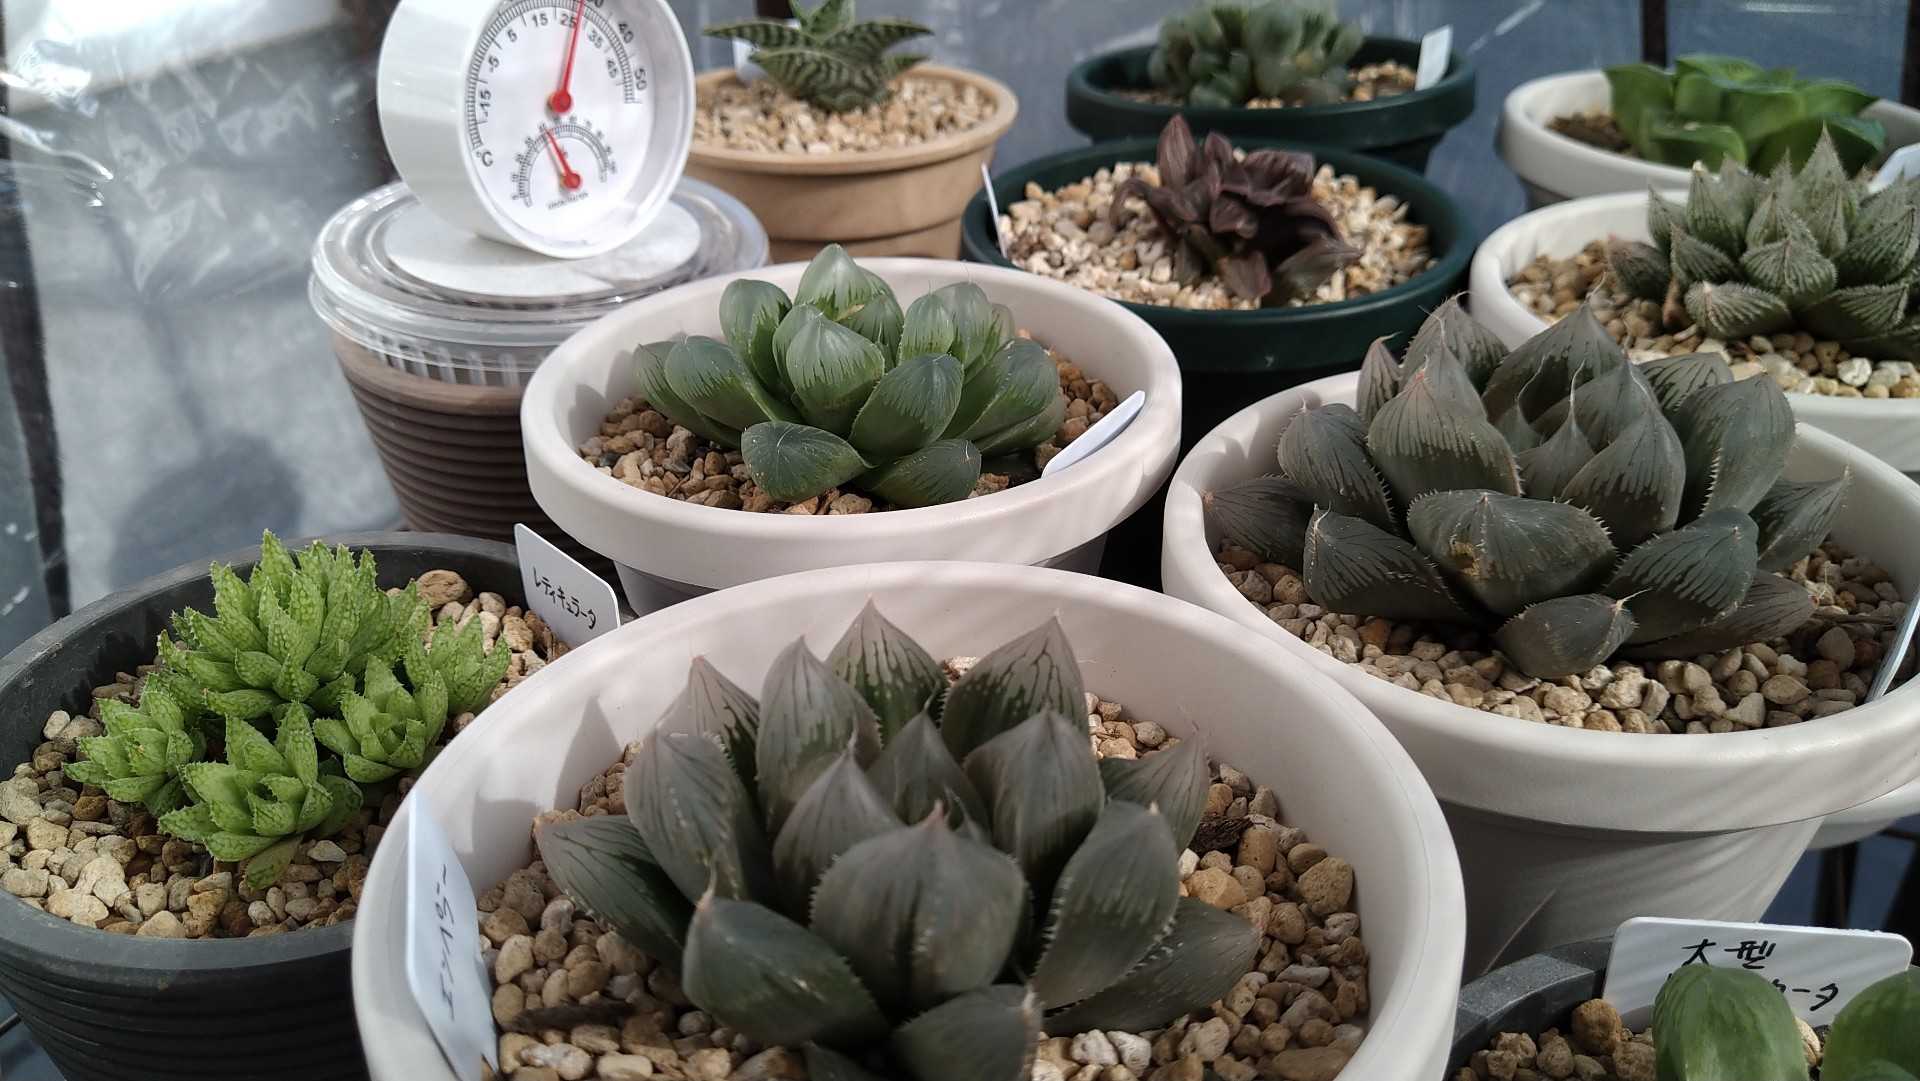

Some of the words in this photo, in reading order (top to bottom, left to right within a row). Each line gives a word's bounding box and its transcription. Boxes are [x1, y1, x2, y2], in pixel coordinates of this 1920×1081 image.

[532, 13, 549, 27] 15
[560, 14, 578, 28] 25
[507, 29, 518, 43] 5
[587, 31, 603, 49] 35
[618, 23, 634, 44] 40
[488, 56, 500, 73] -5
[605, 59, 620, 79] 45
[634, 68, 648, 91] 50
